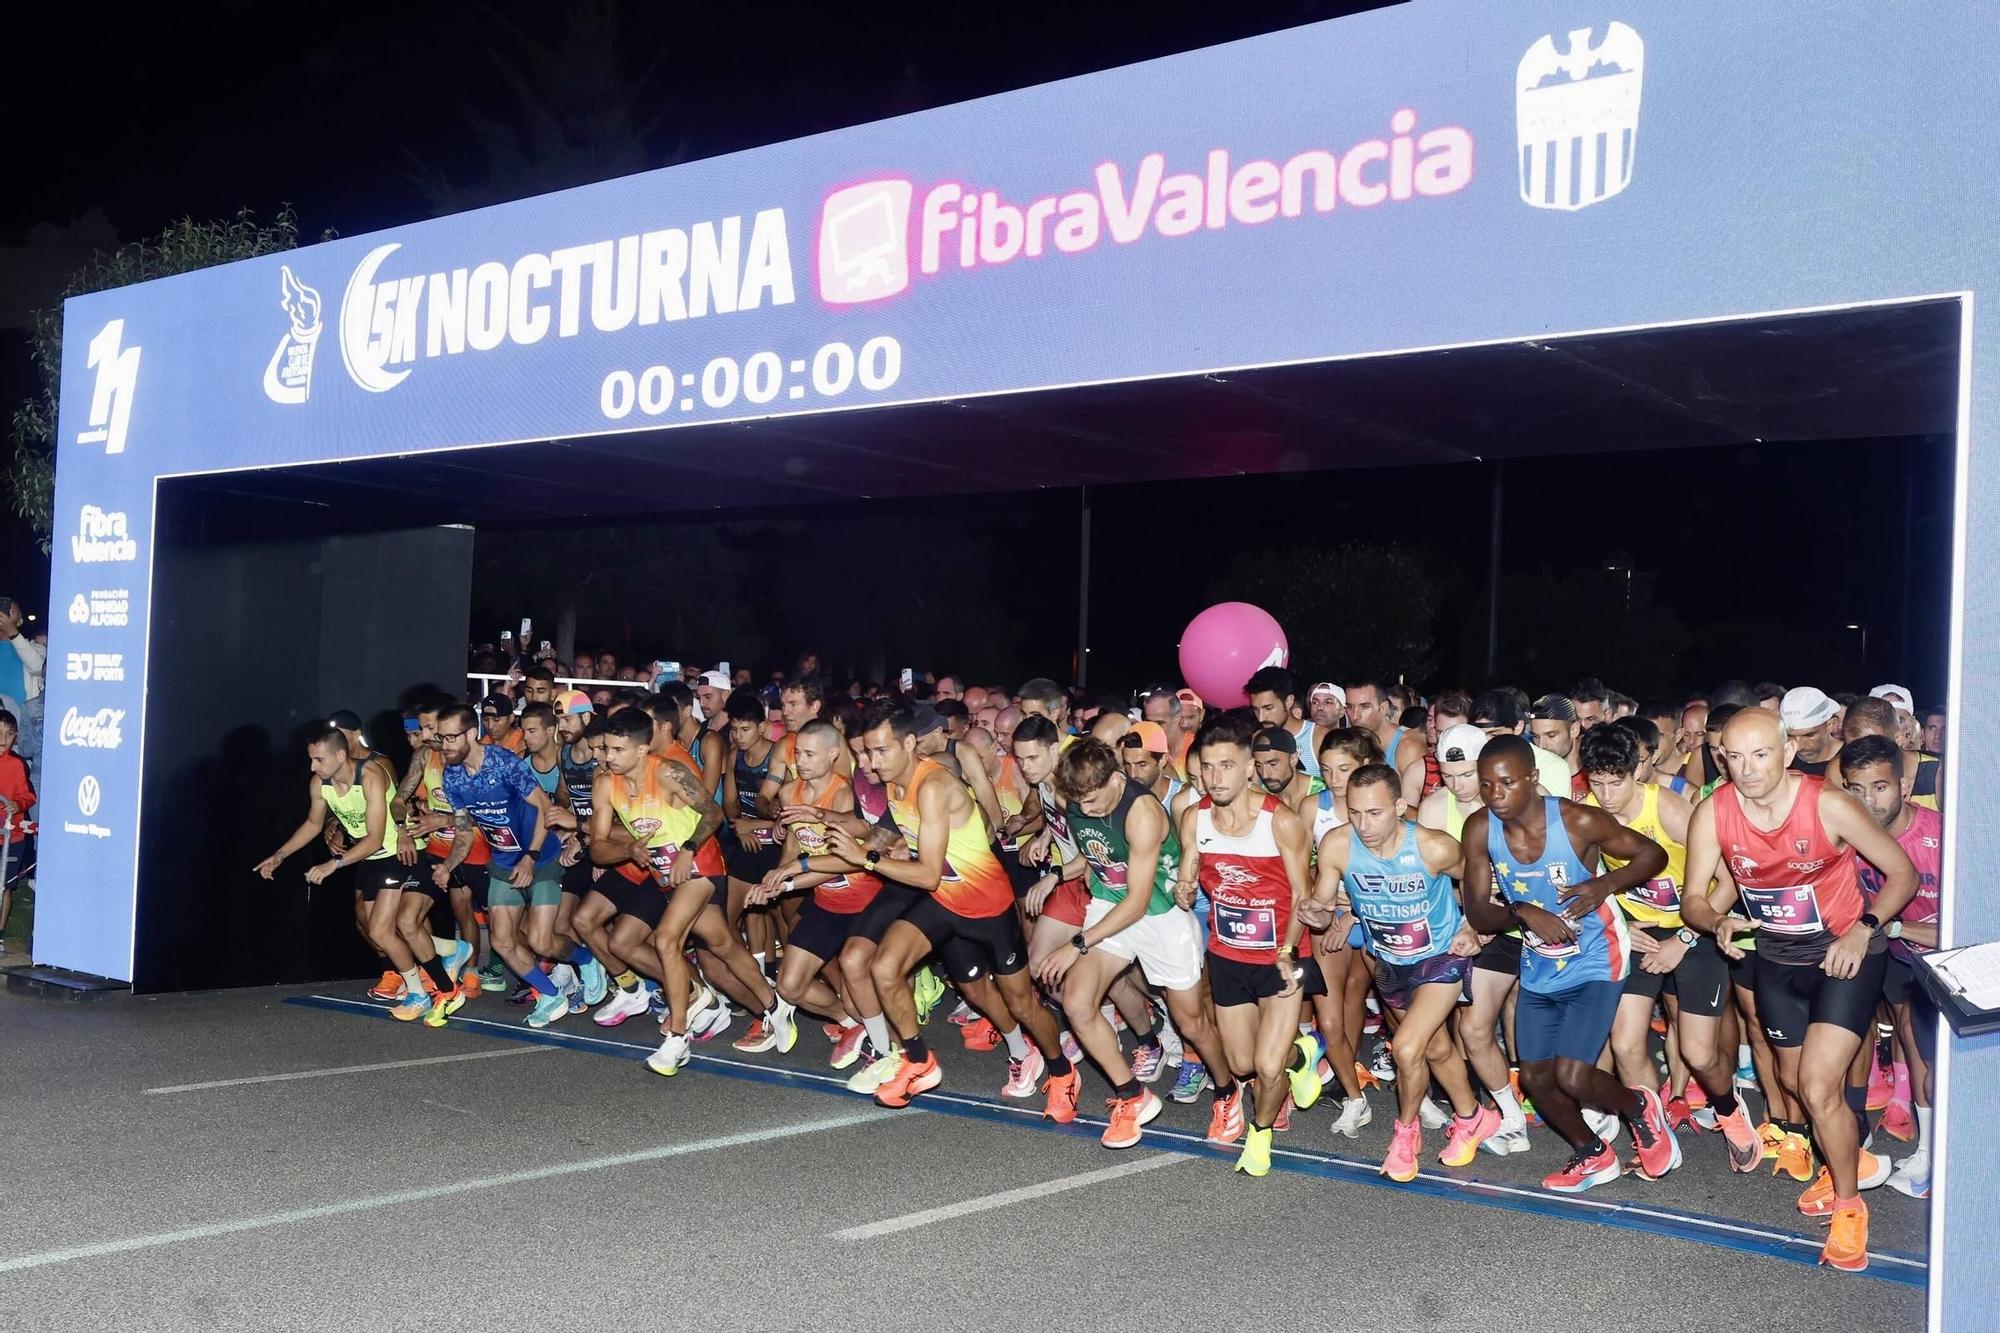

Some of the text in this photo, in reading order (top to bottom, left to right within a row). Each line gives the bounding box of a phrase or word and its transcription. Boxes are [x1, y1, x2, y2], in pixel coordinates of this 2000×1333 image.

[919, 107, 1474, 275] fibraValencia
[426, 207, 796, 358] NOCTURNA
[601, 335, 902, 419] 00:00:00
[576, 807, 593, 816] 100
[651, 855, 672, 866] 103
[1388, 879, 1426, 894] ULSA
[1360, 899, 1430, 919] ATLETISMO
[1760, 904, 1797, 918] 552
[1228, 921, 1257, 935] 109
[1382, 933, 1414, 945] 339
